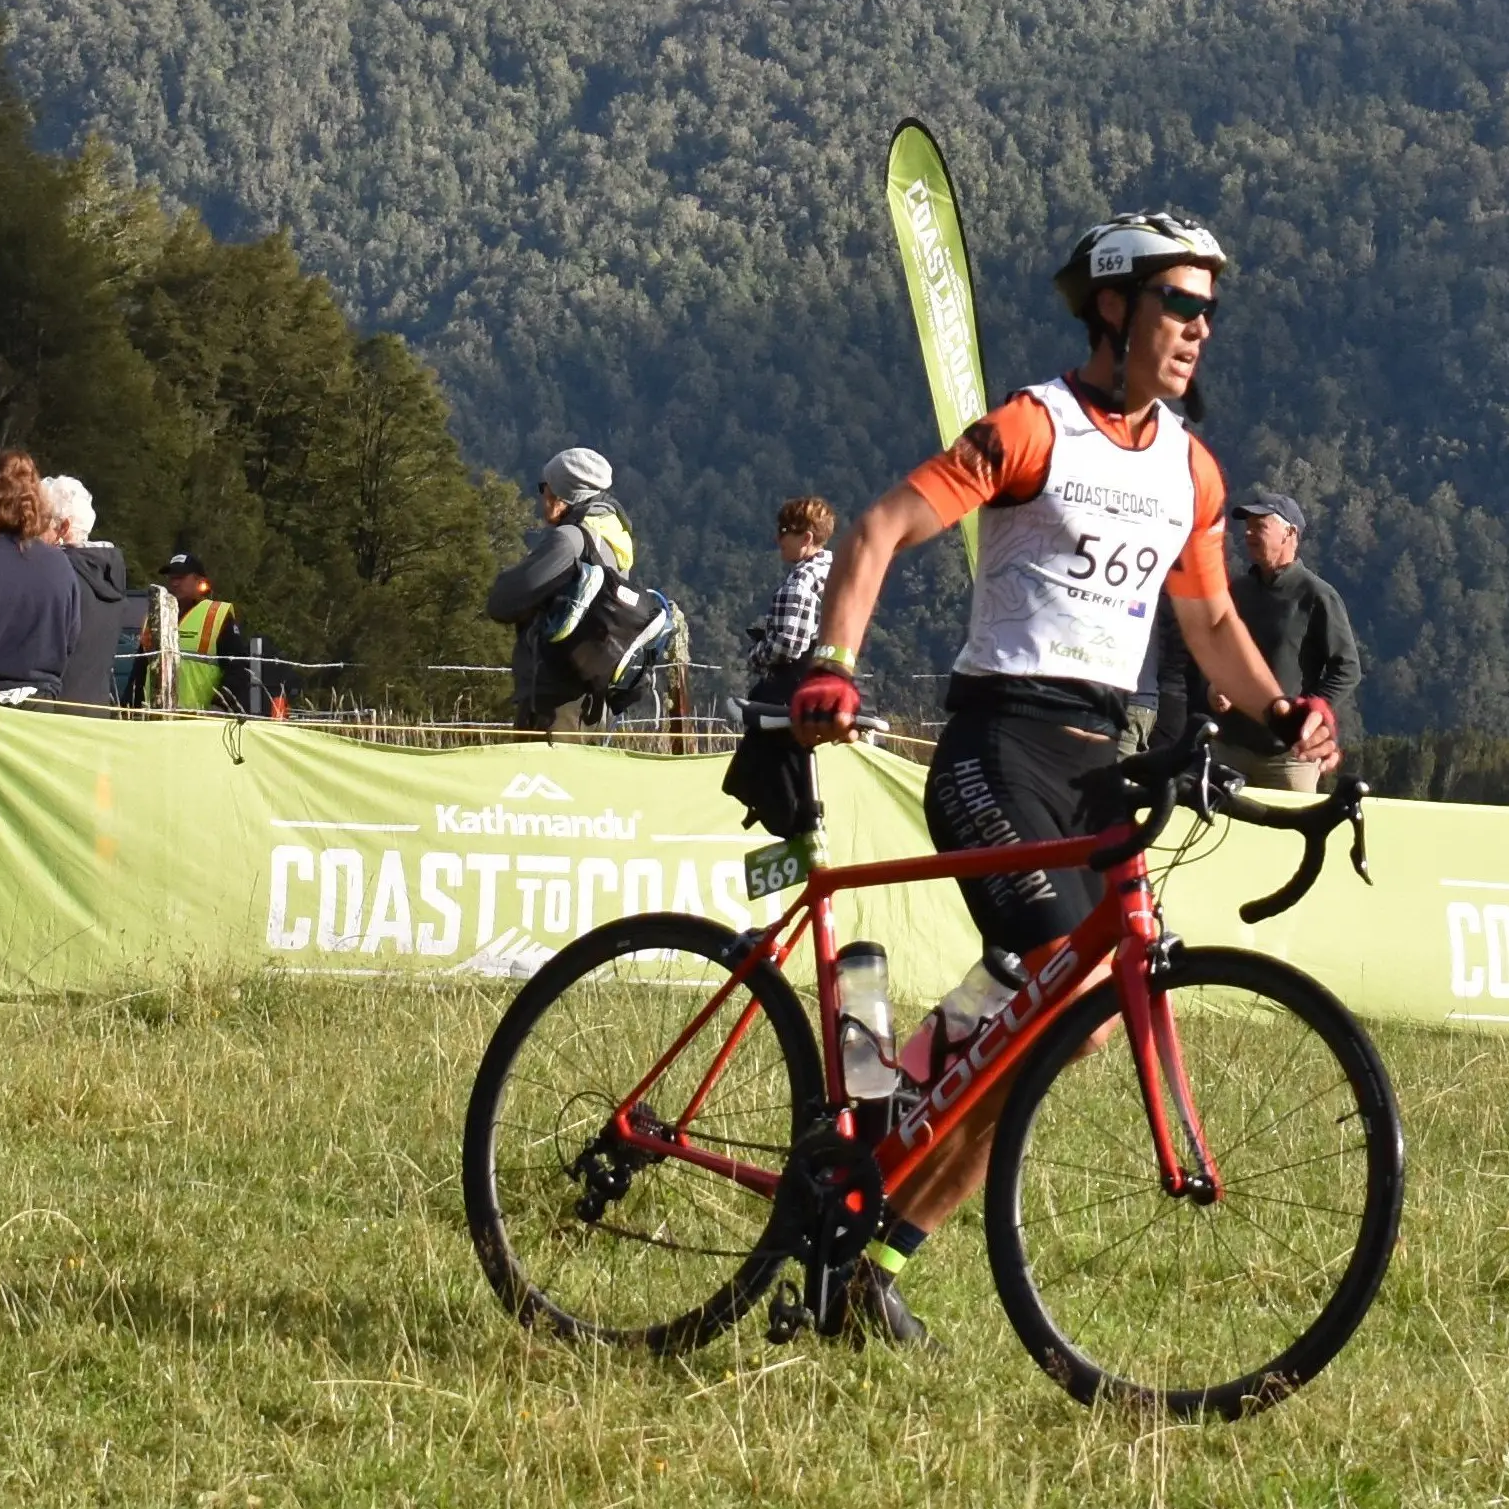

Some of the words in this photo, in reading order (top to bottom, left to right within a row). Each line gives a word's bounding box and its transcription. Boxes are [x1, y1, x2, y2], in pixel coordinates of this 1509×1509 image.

[1097, 255, 1124, 272] 569
[905, 179, 954, 301] COAST
[944, 322, 980, 422] COAS
[1064, 481, 1110, 506] COAST
[1122, 492, 1160, 518] COAST
[1067, 533, 1158, 590] 569
[1067, 587, 1125, 608] GERRIT
[435, 803, 637, 840] Kathmandu
[750, 857, 799, 896] 569
[266, 845, 510, 956] COAST
[516, 877, 572, 933] TO
[898, 940, 1080, 1152] FOCUS
